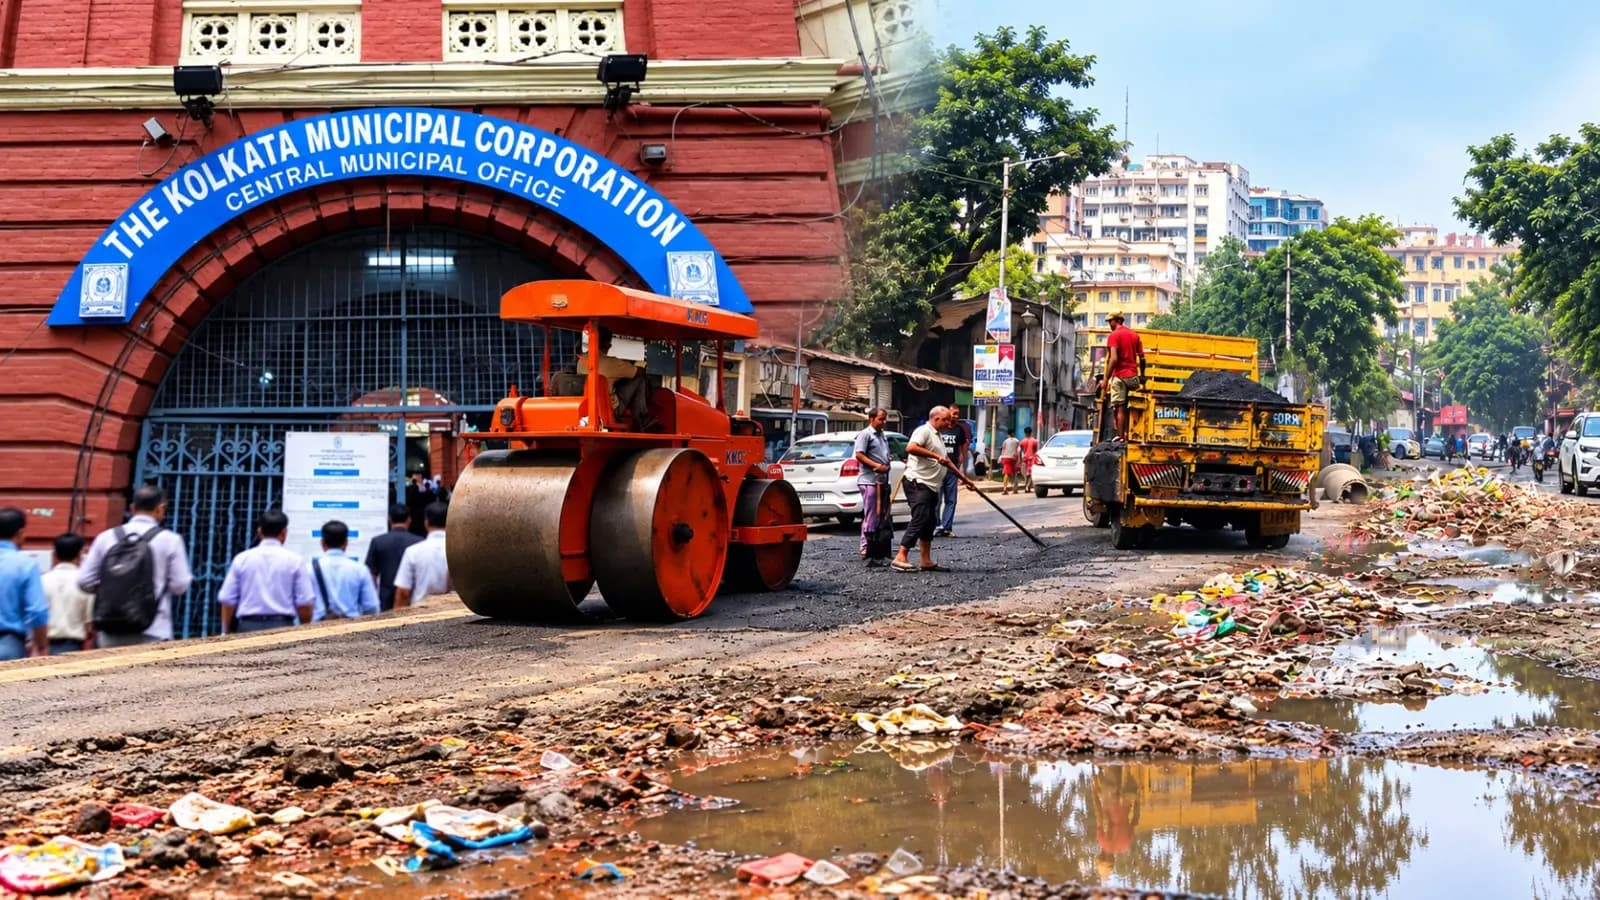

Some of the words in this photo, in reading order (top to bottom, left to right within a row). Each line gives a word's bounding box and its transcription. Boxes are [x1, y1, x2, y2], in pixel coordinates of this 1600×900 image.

[103, 198, 168, 259] THE
[162, 130, 299, 214] KOLKATA
[305, 112, 466, 154] MUNICIPAL
[474, 121, 686, 247] CORPORATION
[226, 161, 333, 211] CENTRAL
[341, 152, 467, 175] MUNICIPAL
[478, 162, 566, 207] OFFICE
